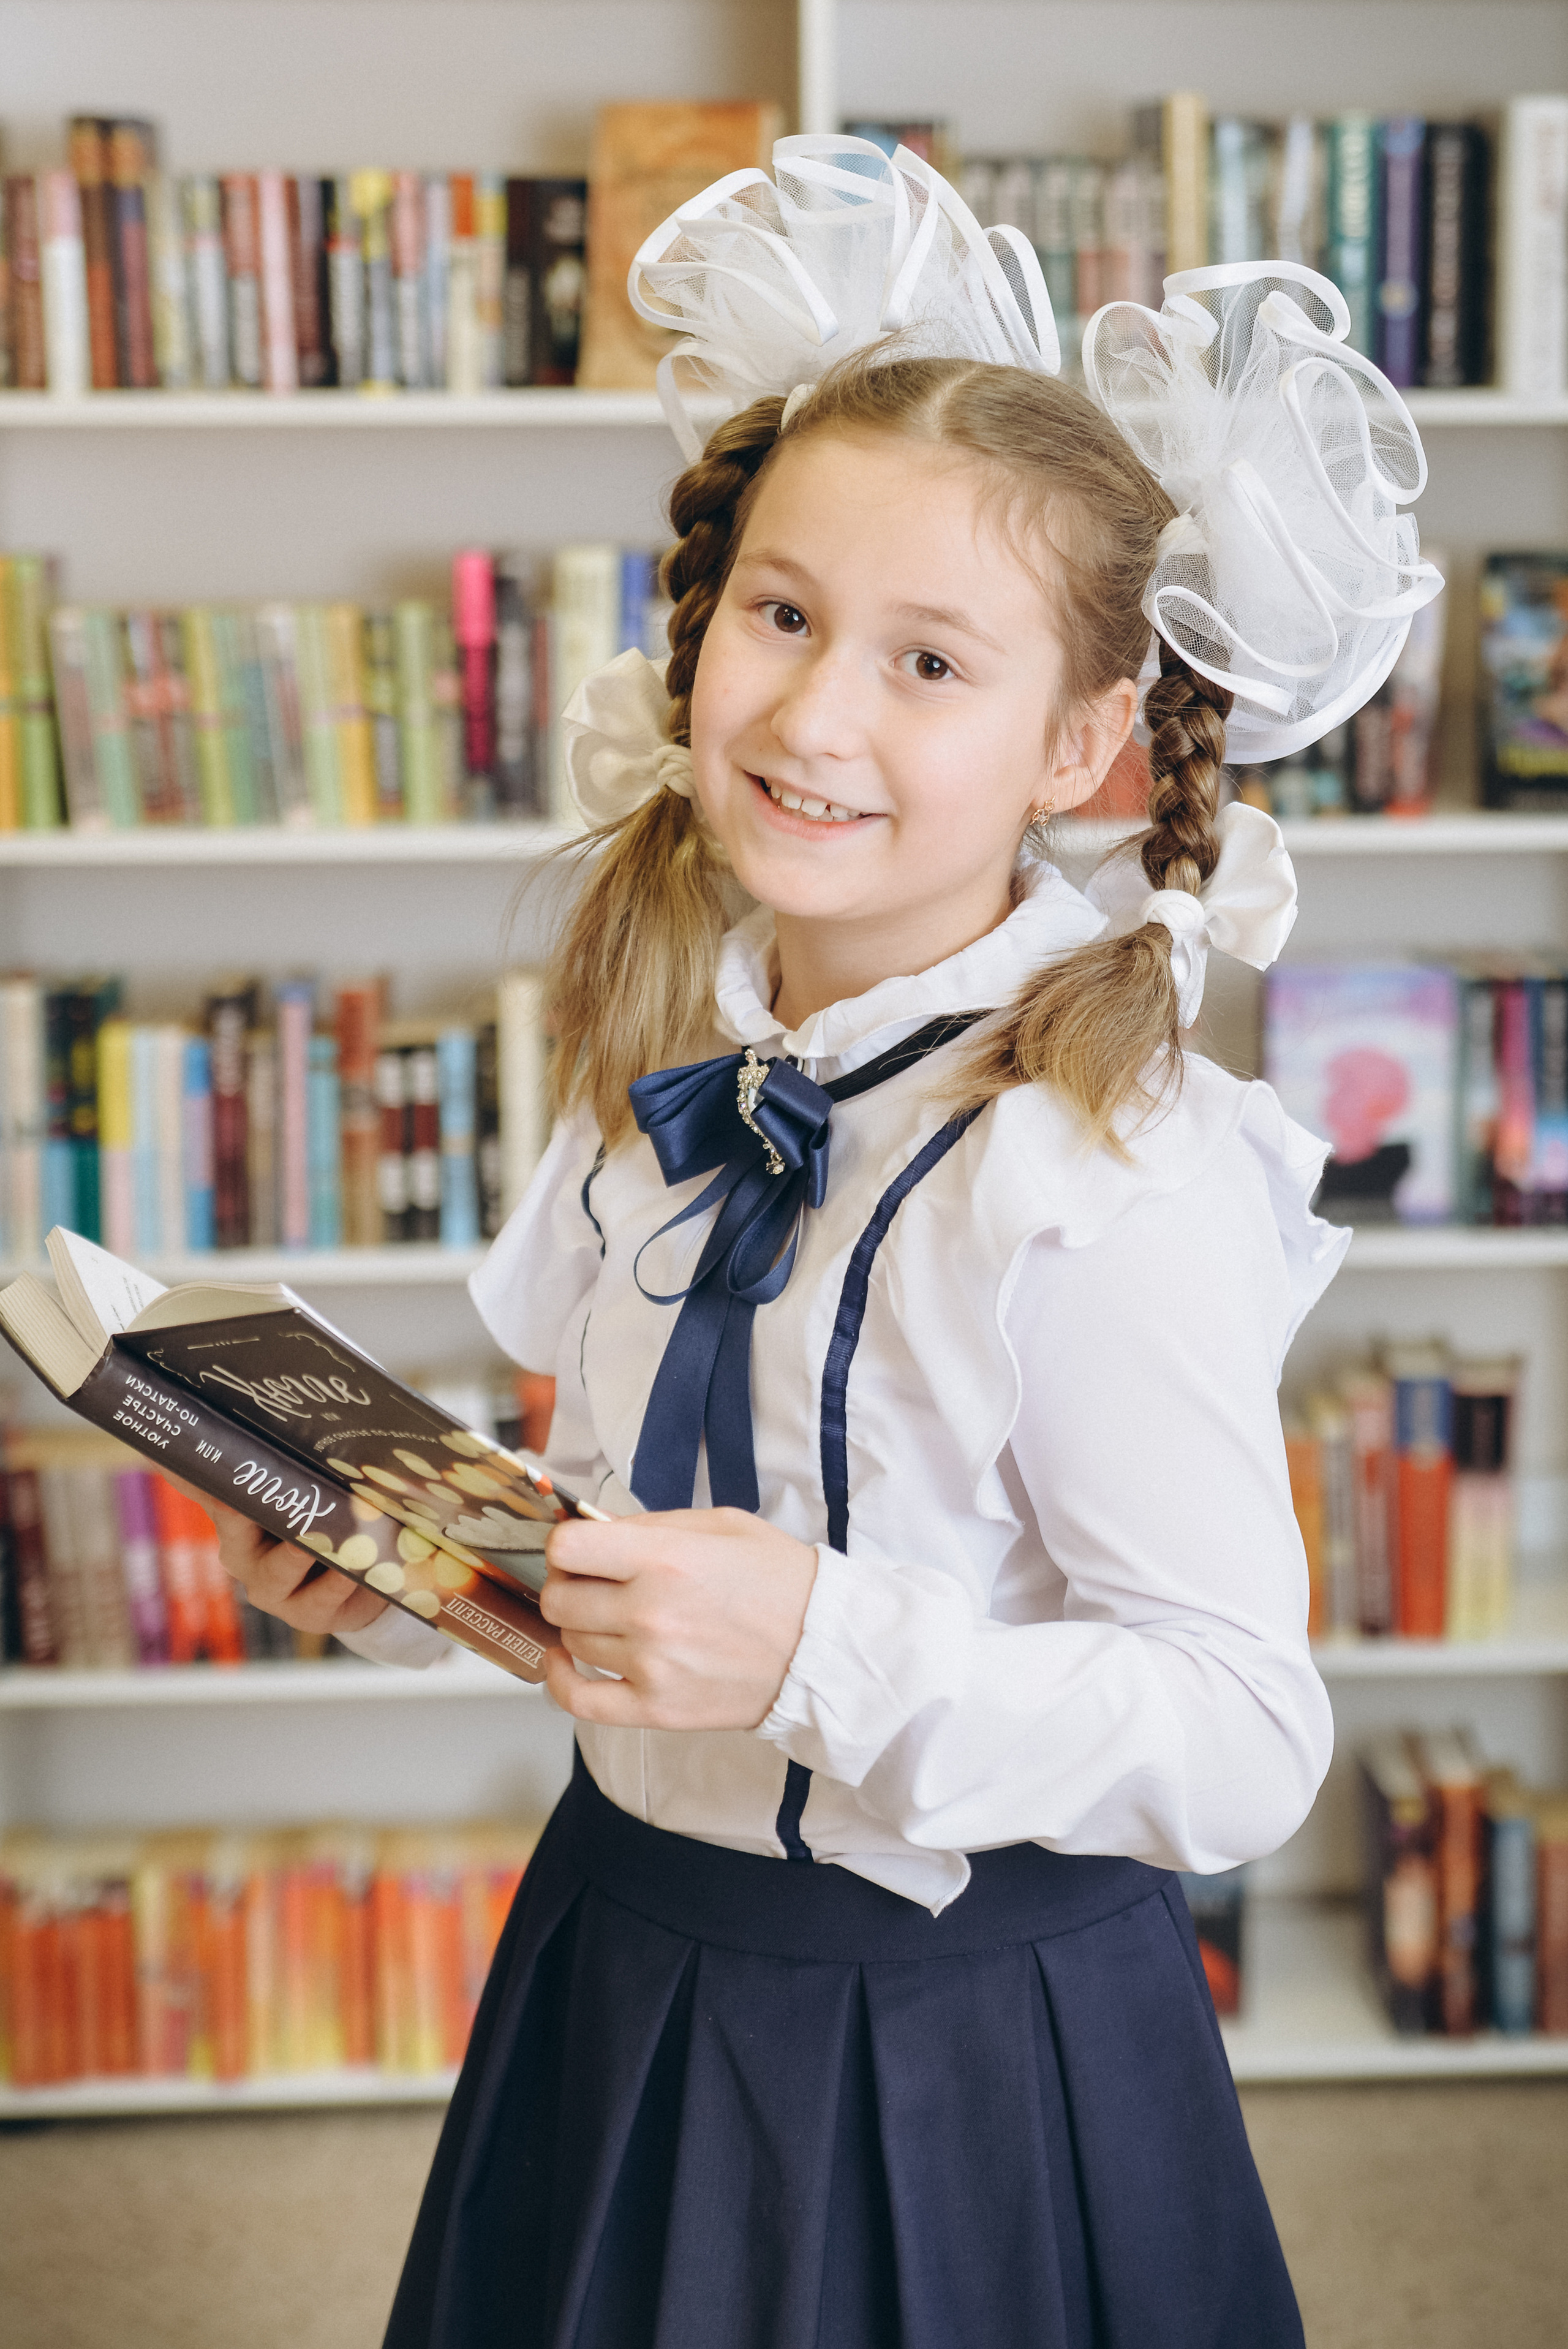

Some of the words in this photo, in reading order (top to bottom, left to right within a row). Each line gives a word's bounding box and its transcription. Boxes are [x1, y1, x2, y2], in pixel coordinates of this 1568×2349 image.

[125, 1374, 200, 1427] ПО-ДАТСКИ
[199, 1364, 371, 1423] Хюгге
[113, 1410, 170, 1450] УЮТНОЕ
[123, 1394, 181, 1436] СЧАСТЬЕ
[195, 1440, 223, 1464] ИЛИ
[233, 1461, 337, 1540] Хюгге
[445, 1597, 506, 1640] РАССЕЛЛ
[502, 1633, 544, 1665] ХЕЛЕН
